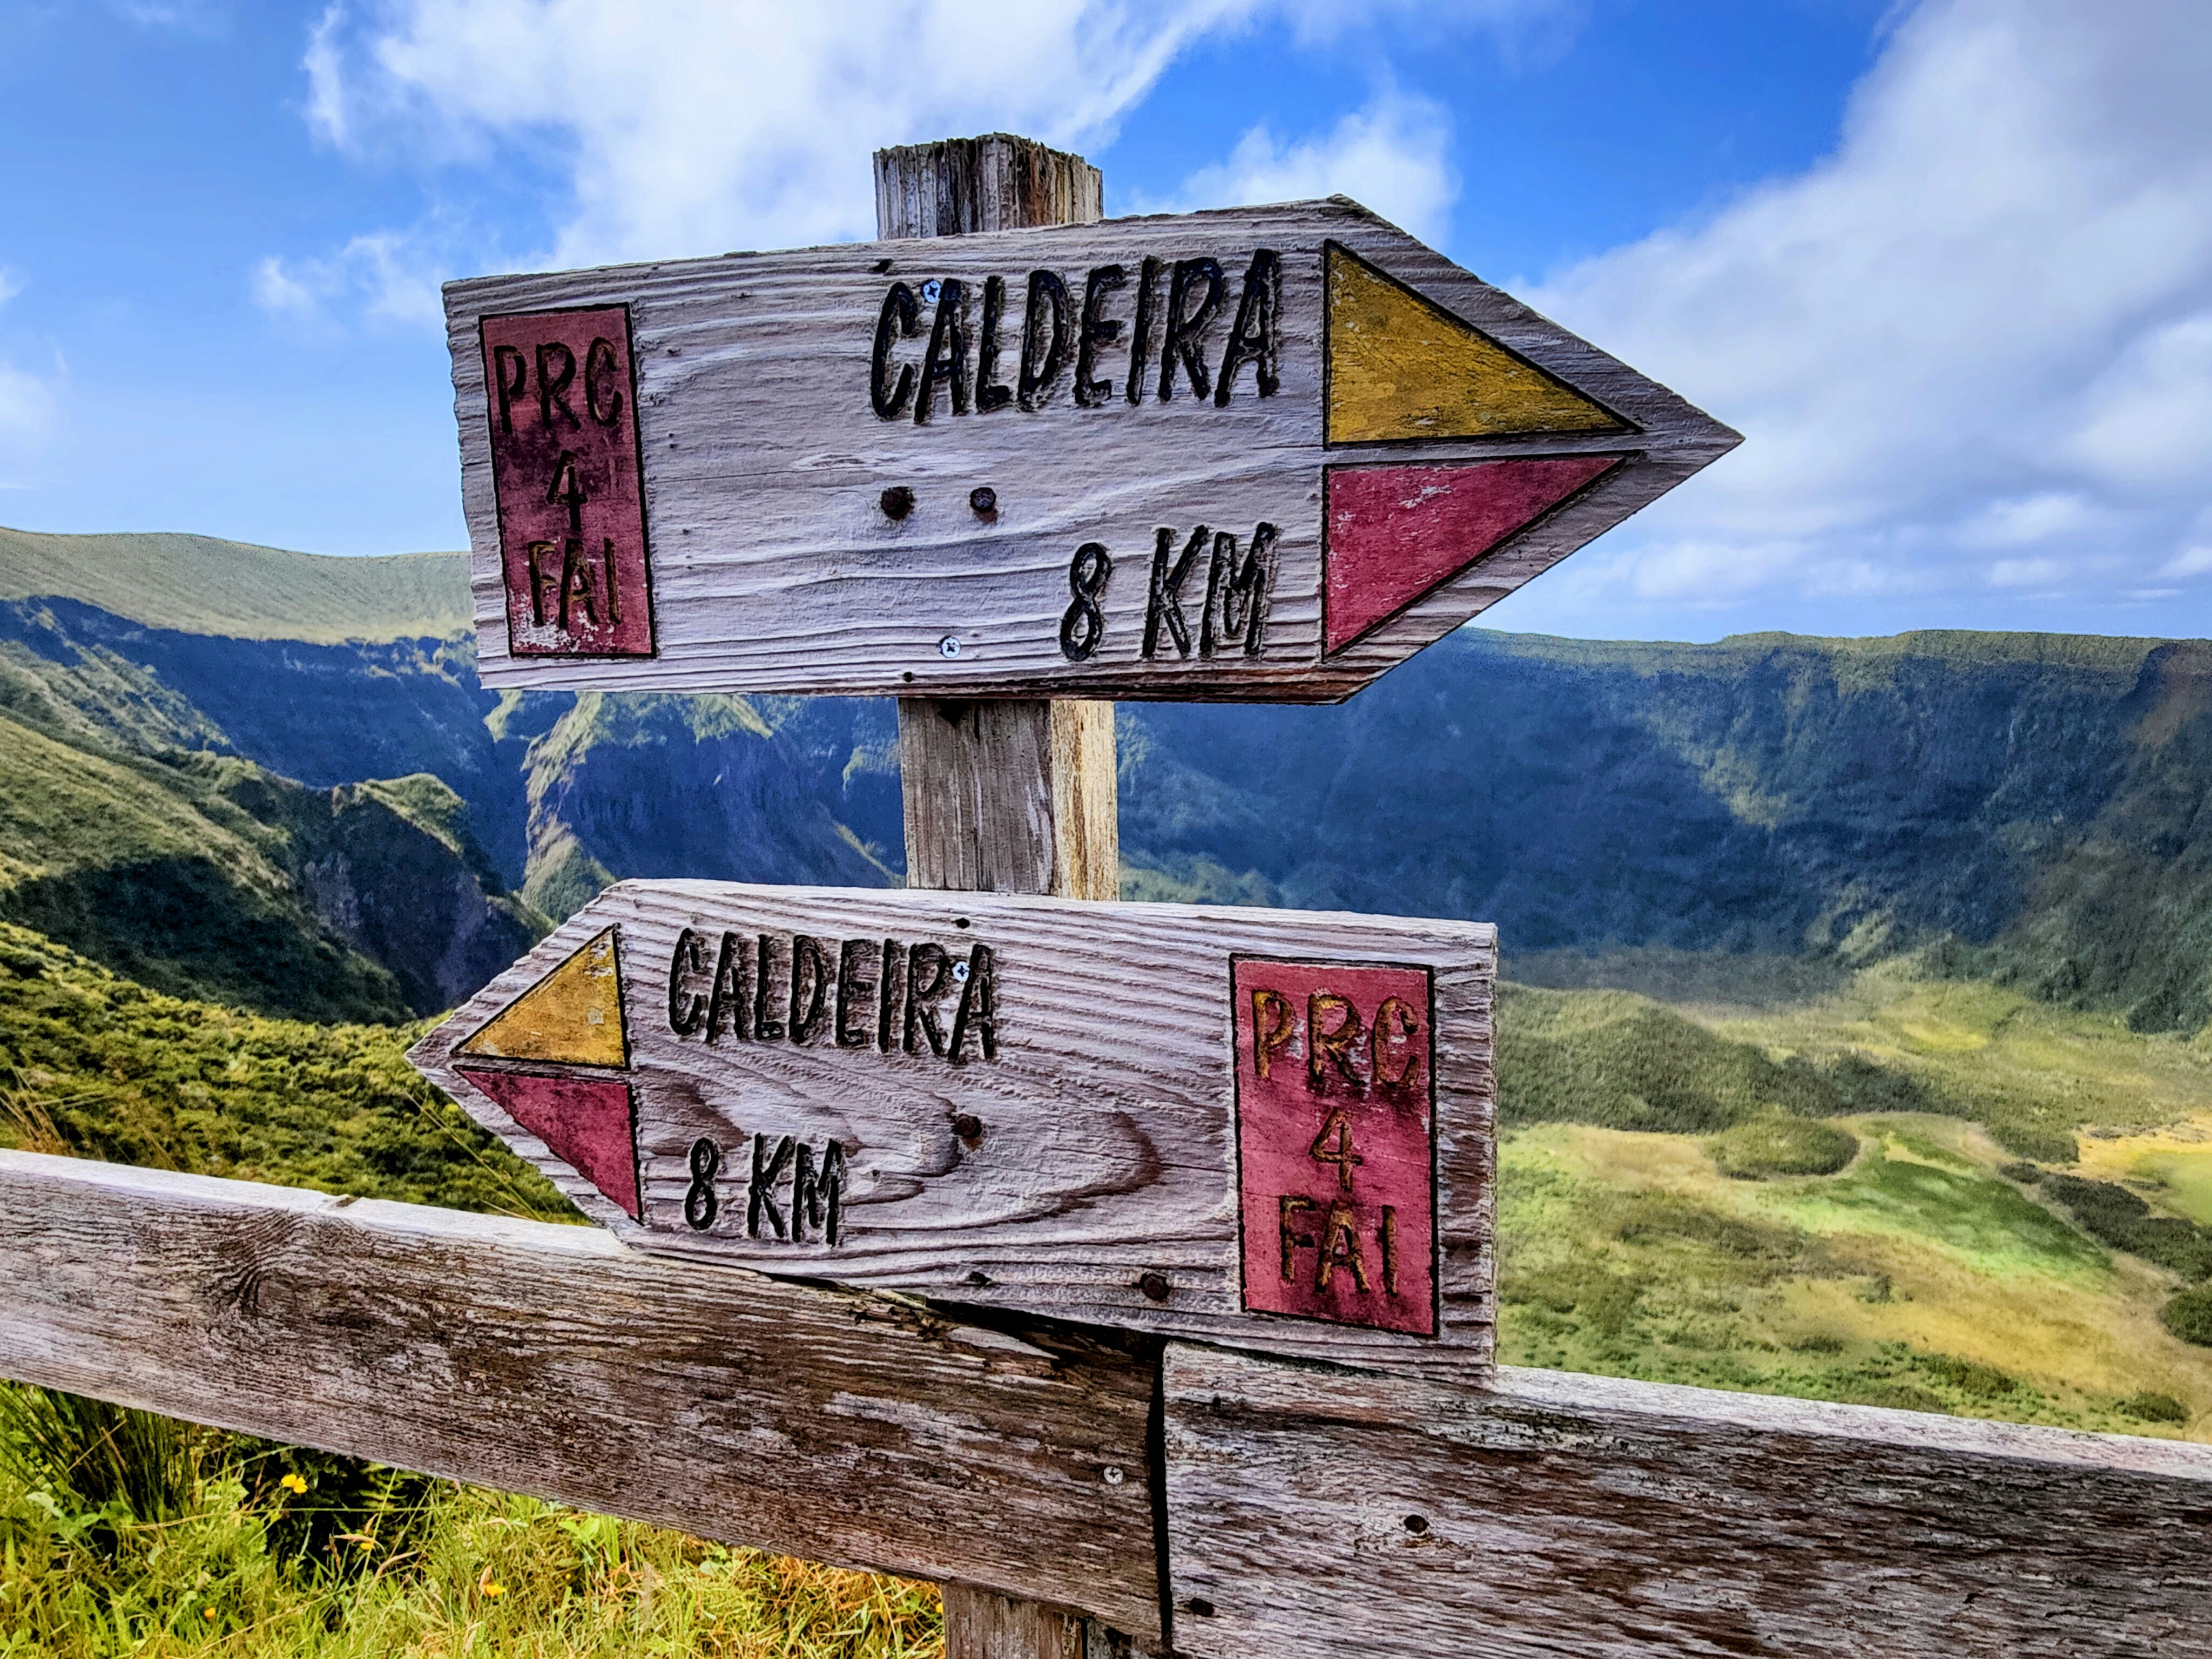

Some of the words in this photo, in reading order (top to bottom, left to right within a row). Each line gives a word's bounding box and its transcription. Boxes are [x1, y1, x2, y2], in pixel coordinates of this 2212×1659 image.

[494, 336, 623, 434] PRC
[871, 248, 1280, 424] CALDEIRA
[546, 450, 588, 532] 4
[527, 538, 621, 630] FAI
[1060, 542, 1112, 662] 8
[1141, 522, 1278, 661] KM
[669, 927, 995, 1060] CALDEIRA
[1252, 989, 1420, 1089] PRC
[684, 1137, 719, 1231] 8
[747, 1132, 843, 1246] KM
[1309, 1106, 1364, 1192] 4
[1279, 1195, 1398, 1296] FAI
